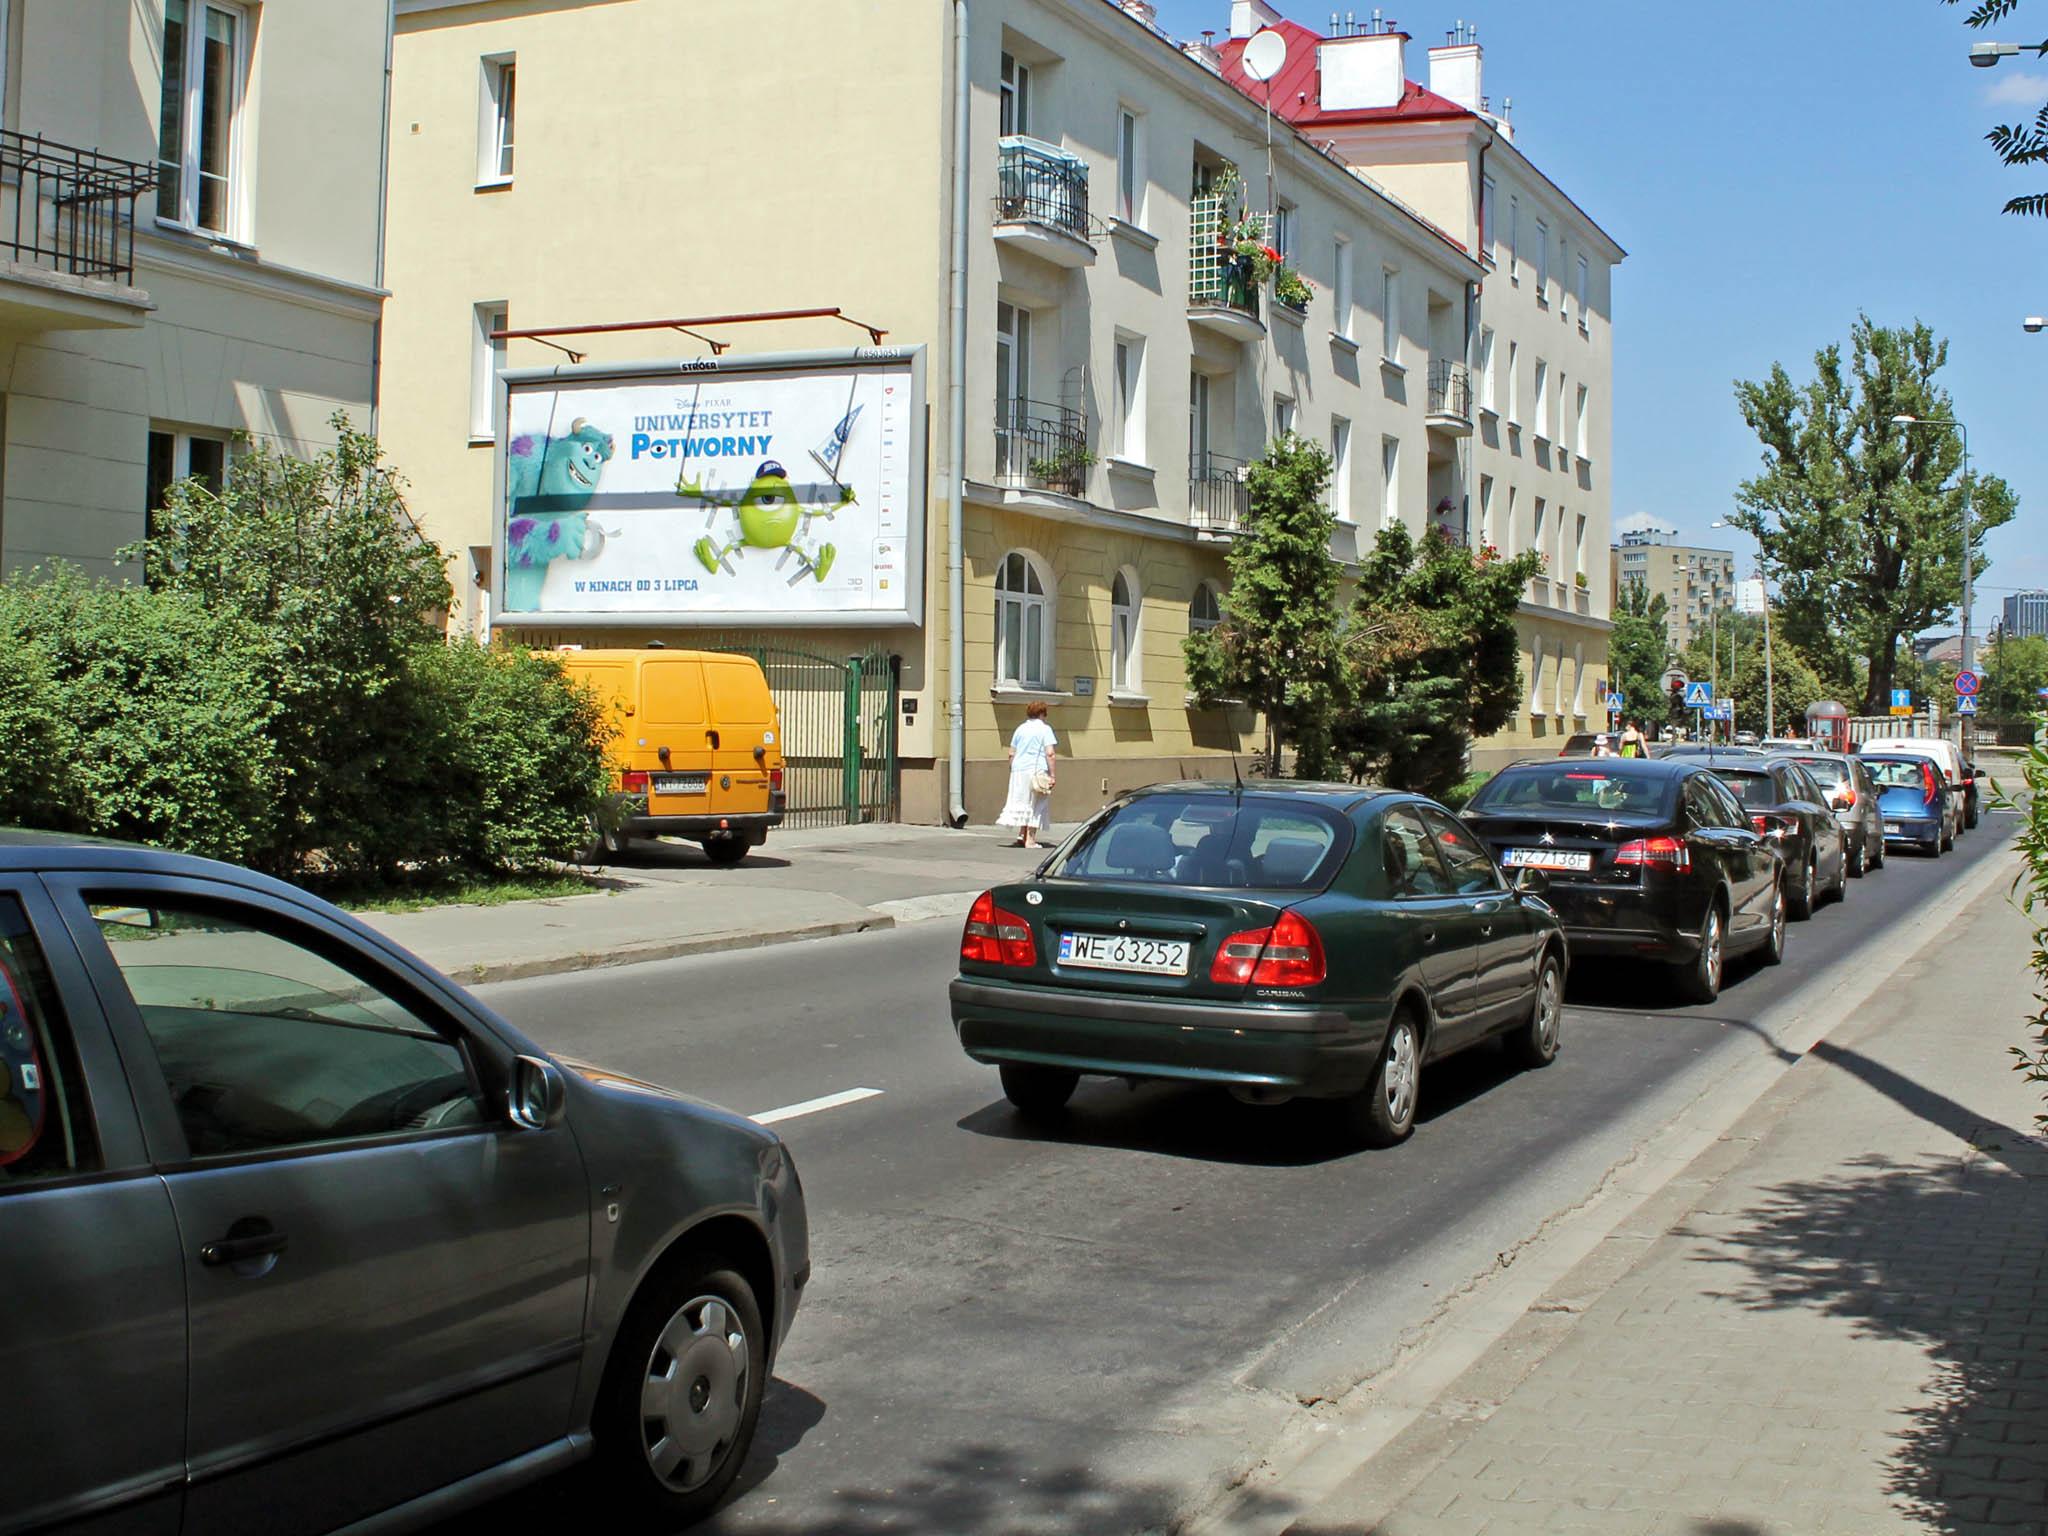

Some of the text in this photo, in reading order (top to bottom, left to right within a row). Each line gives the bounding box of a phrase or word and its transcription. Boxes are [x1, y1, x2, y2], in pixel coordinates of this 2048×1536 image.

[705, 399, 732, 407] PIXAR
[634, 410, 773, 432] UNIWERSYTET
[574, 579, 699, 592] W KINACH OD 3 LIPCA
[1513, 849, 1589, 867] WZ 7136F
[1075, 936, 1184, 967] WE 63252
[1256, 989, 1306, 998] CARISMA
